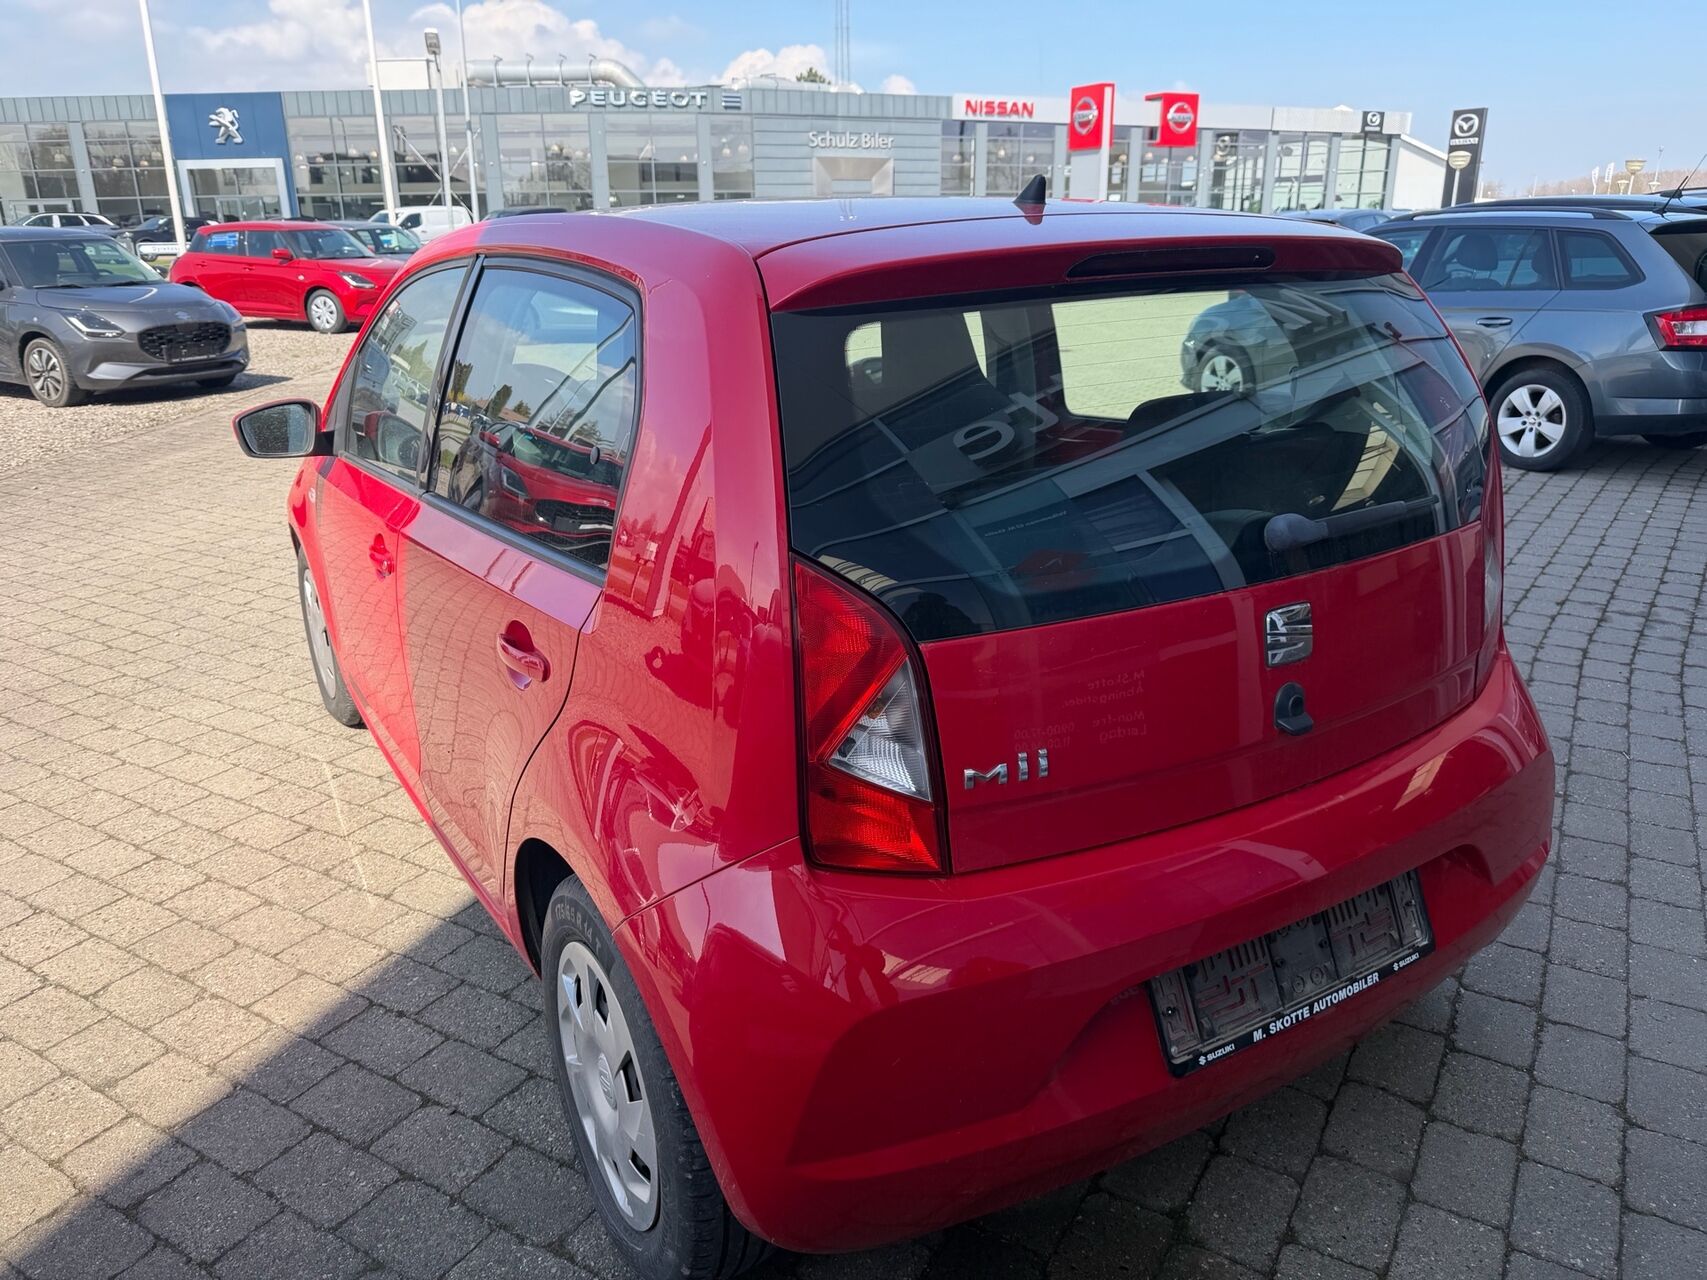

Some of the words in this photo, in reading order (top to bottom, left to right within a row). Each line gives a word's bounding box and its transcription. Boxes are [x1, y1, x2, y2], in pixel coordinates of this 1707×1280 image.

[569, 89, 708, 109] PEUGEOT
[965, 99, 1034, 119] NISSAN
[808, 131, 858, 149] Schulz
[861, 131, 895, 150] Biler
[1398, 951, 1420, 968] SUZUKI
[1252, 1028, 1267, 1043] M.
[1269, 1006, 1311, 1035] SKOTTE
[1313, 971, 1381, 1014] AUTOMOBILER
[1206, 1043, 1236, 1061] SUZUKI
